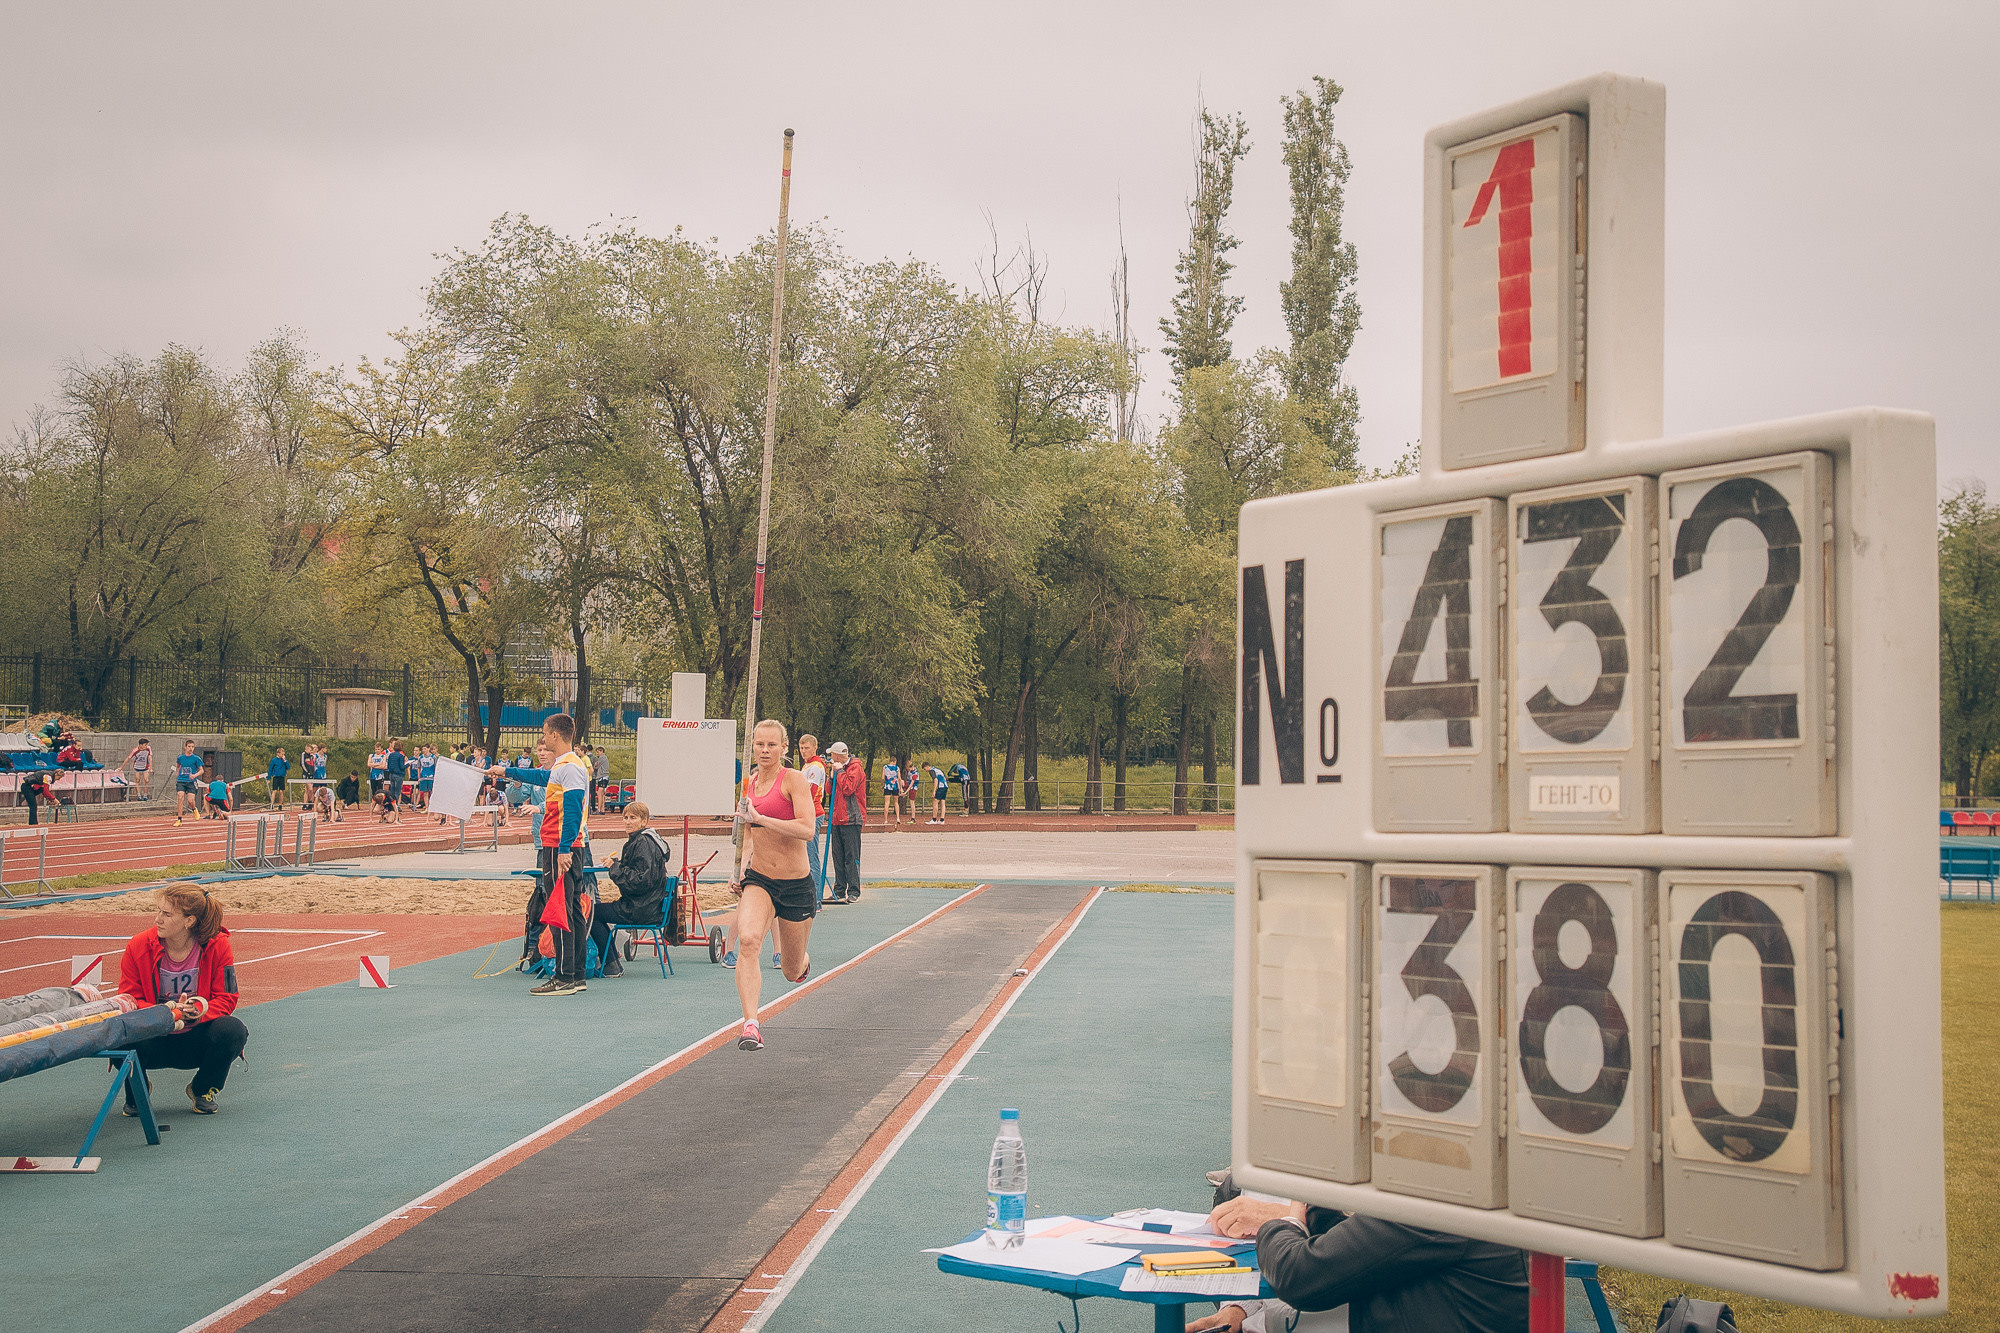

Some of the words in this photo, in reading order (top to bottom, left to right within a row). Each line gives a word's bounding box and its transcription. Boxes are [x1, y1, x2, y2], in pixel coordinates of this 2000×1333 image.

[1463, 138, 1536, 379] 1
[662, 721, 699, 729] ERHARD
[700, 721, 720, 730] SPORT
[1538, 785, 1612, 805] ГЕНГ-ГО
[171, 974, 192, 994] 12
